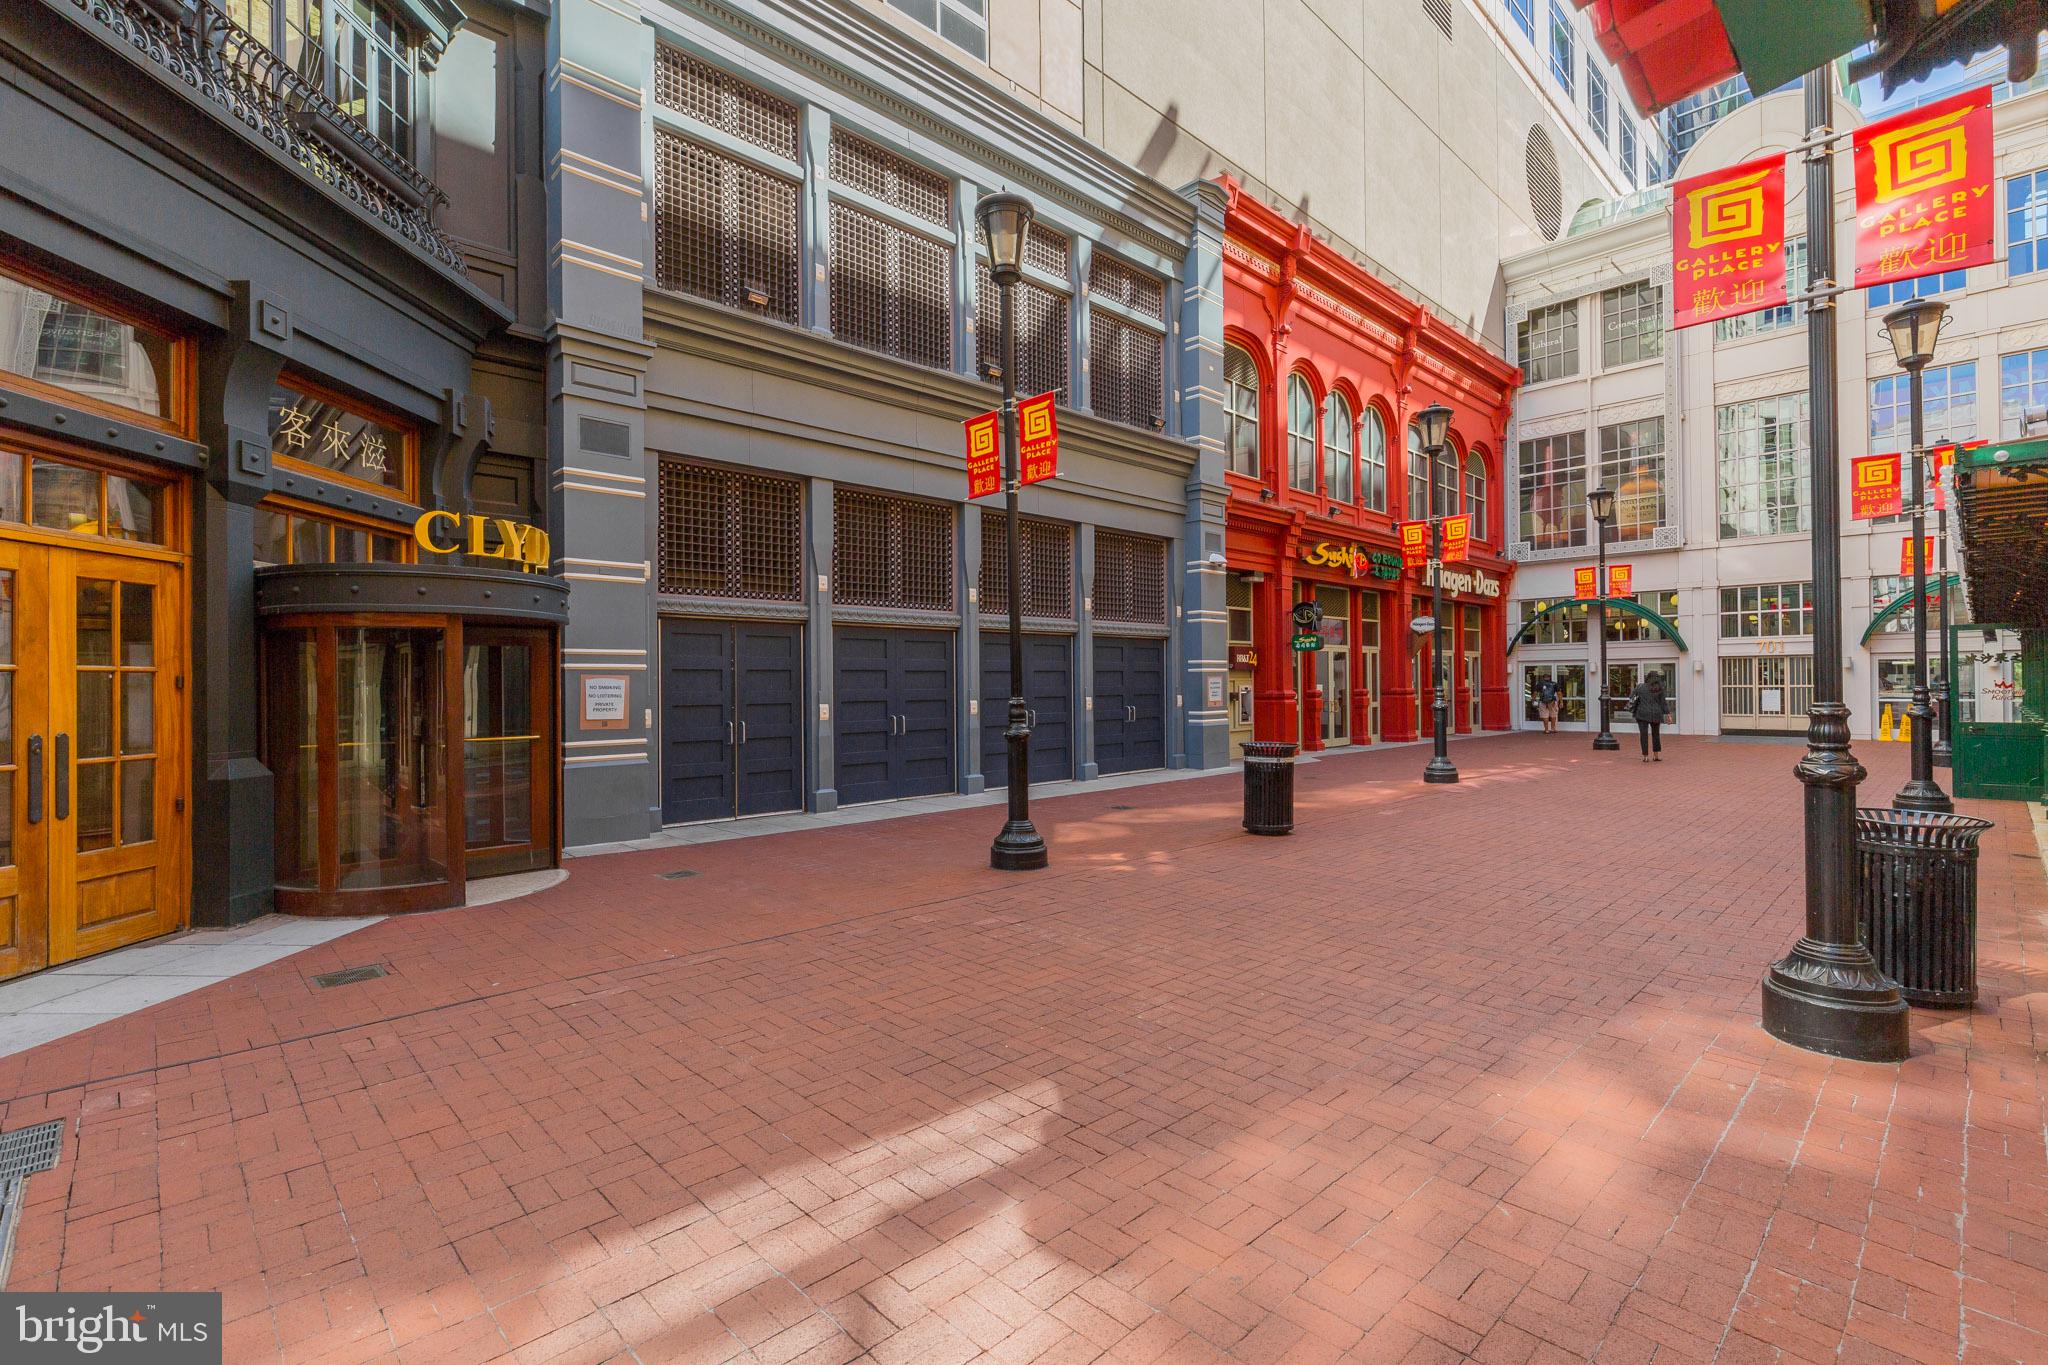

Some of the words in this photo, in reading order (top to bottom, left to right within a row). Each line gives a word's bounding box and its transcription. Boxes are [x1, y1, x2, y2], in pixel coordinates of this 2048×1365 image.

[1859, 184, 1990, 228] GALLERY
[1879, 205, 1967, 237] PLACE
[1676, 241, 1781, 272] GALLERY
[1879, 231, 1969, 277] 歡迎
[1692, 257, 1764, 280] PLACE
[1692, 278, 1765, 317] 歡迎
[1532, 335, 1563, 351] Liberal
[279, 405, 388, 473] 客來滋
[1020, 439, 1057, 454] GALLERY
[967, 455, 999, 469] GALLERY
[1026, 448, 1051, 460] PLACE
[973, 464, 995, 475] PLACE
[1852, 487, 1900, 497] GALLERY
[1860, 493, 1893, 501] PLACE
[1756, 639, 1785, 654] 701
